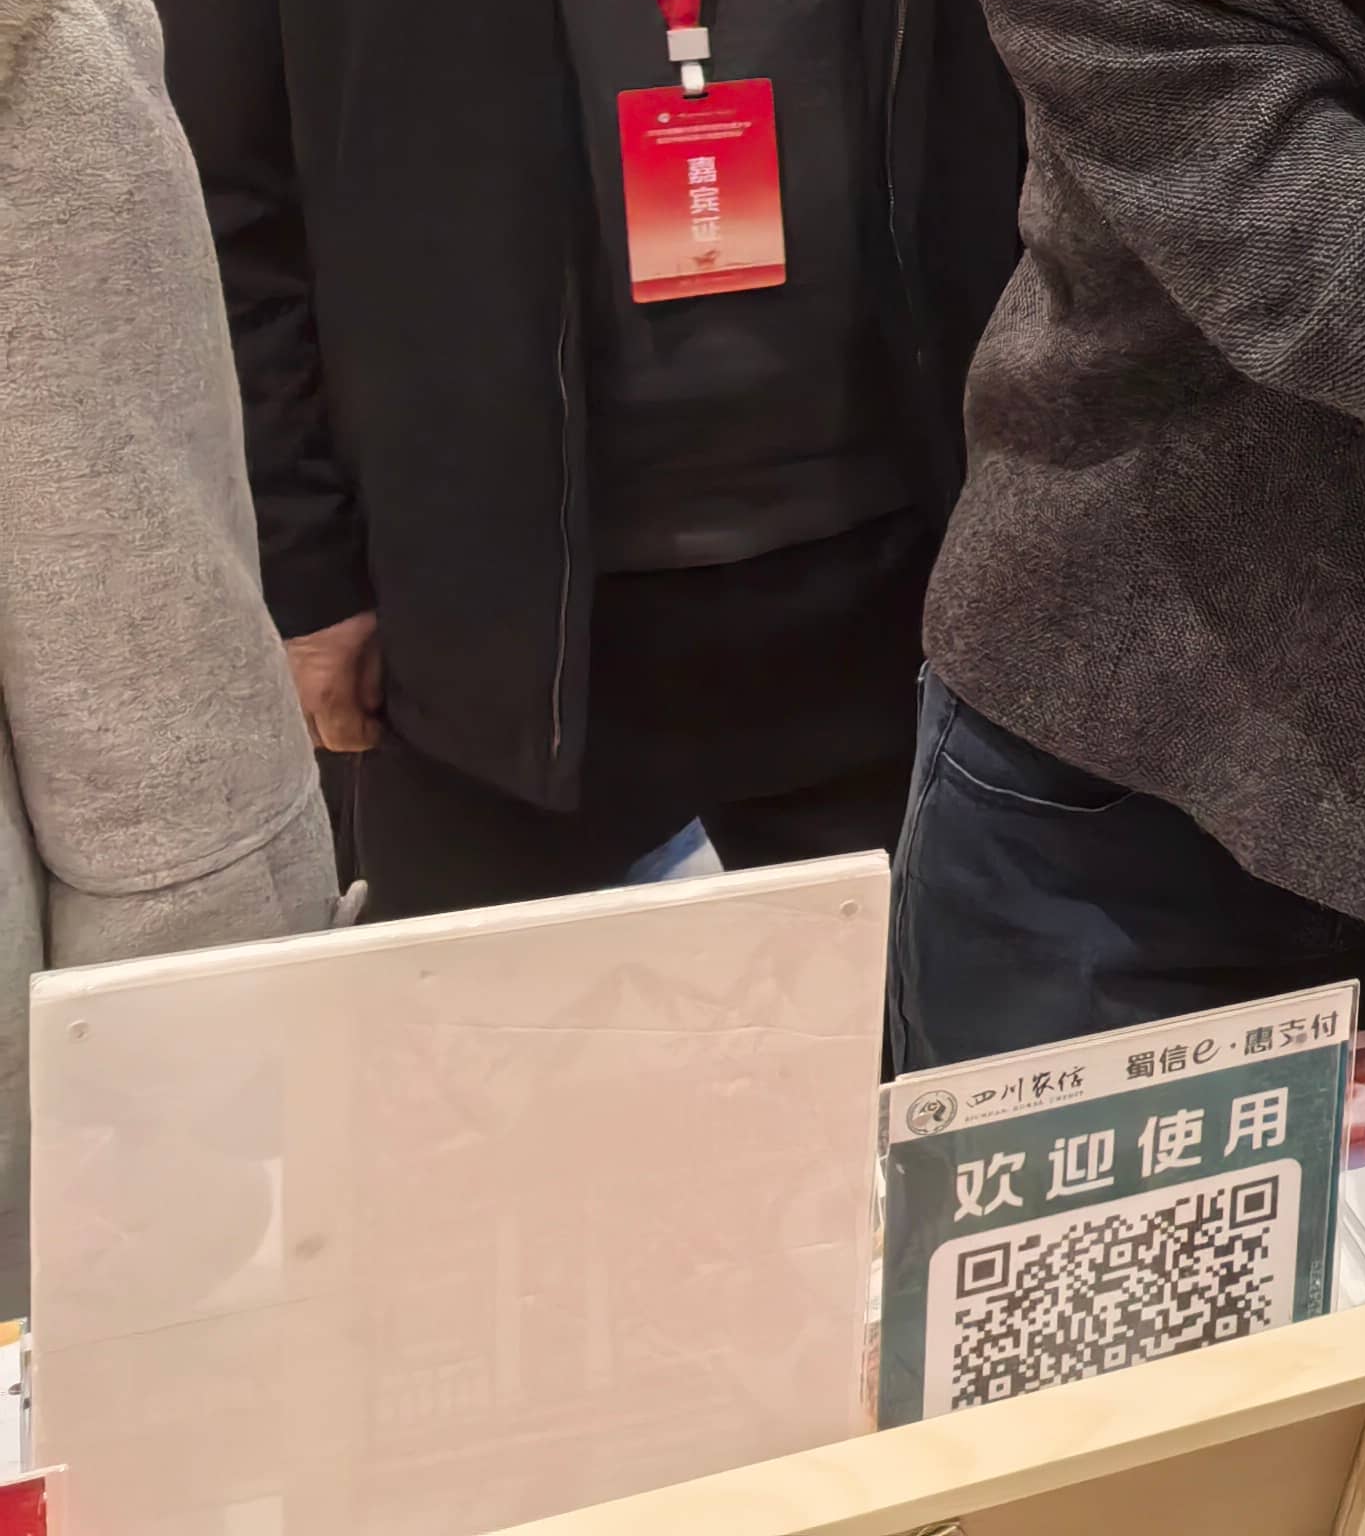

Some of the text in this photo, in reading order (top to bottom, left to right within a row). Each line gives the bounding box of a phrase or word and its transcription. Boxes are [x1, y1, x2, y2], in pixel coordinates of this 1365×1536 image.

[966, 1066, 1086, 1109] 四川农信
[953, 1086, 1289, 1223] 欢迎使用
